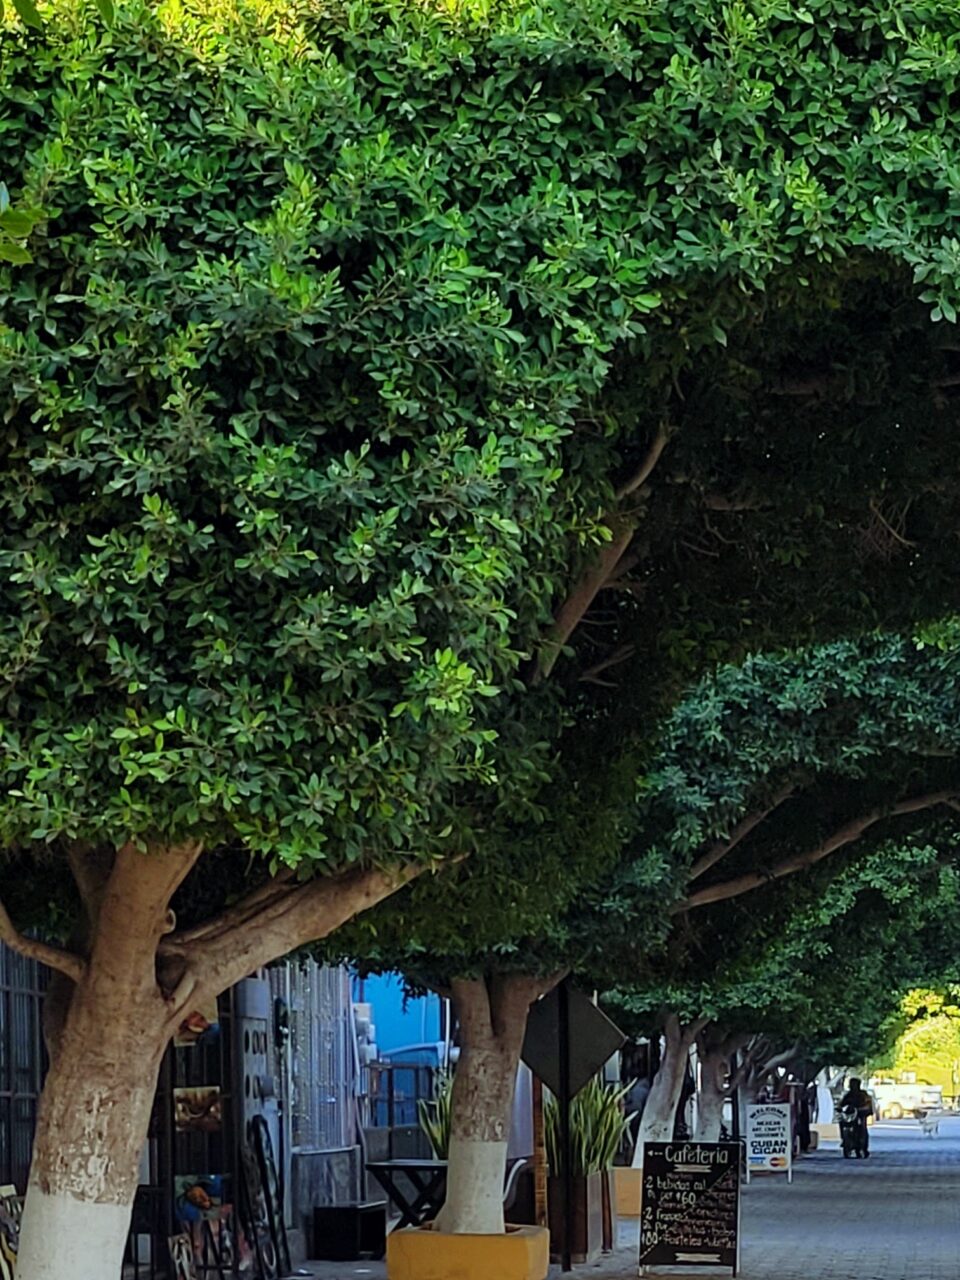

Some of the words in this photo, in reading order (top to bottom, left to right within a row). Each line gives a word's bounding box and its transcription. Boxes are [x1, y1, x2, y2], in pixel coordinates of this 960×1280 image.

[749, 1107, 787, 1119] WELCOME
[665, 1144, 729, 1164] Cafeteria
[752, 1147, 786, 1155] CIGAR
[645, 1206, 653, 1220] 2
